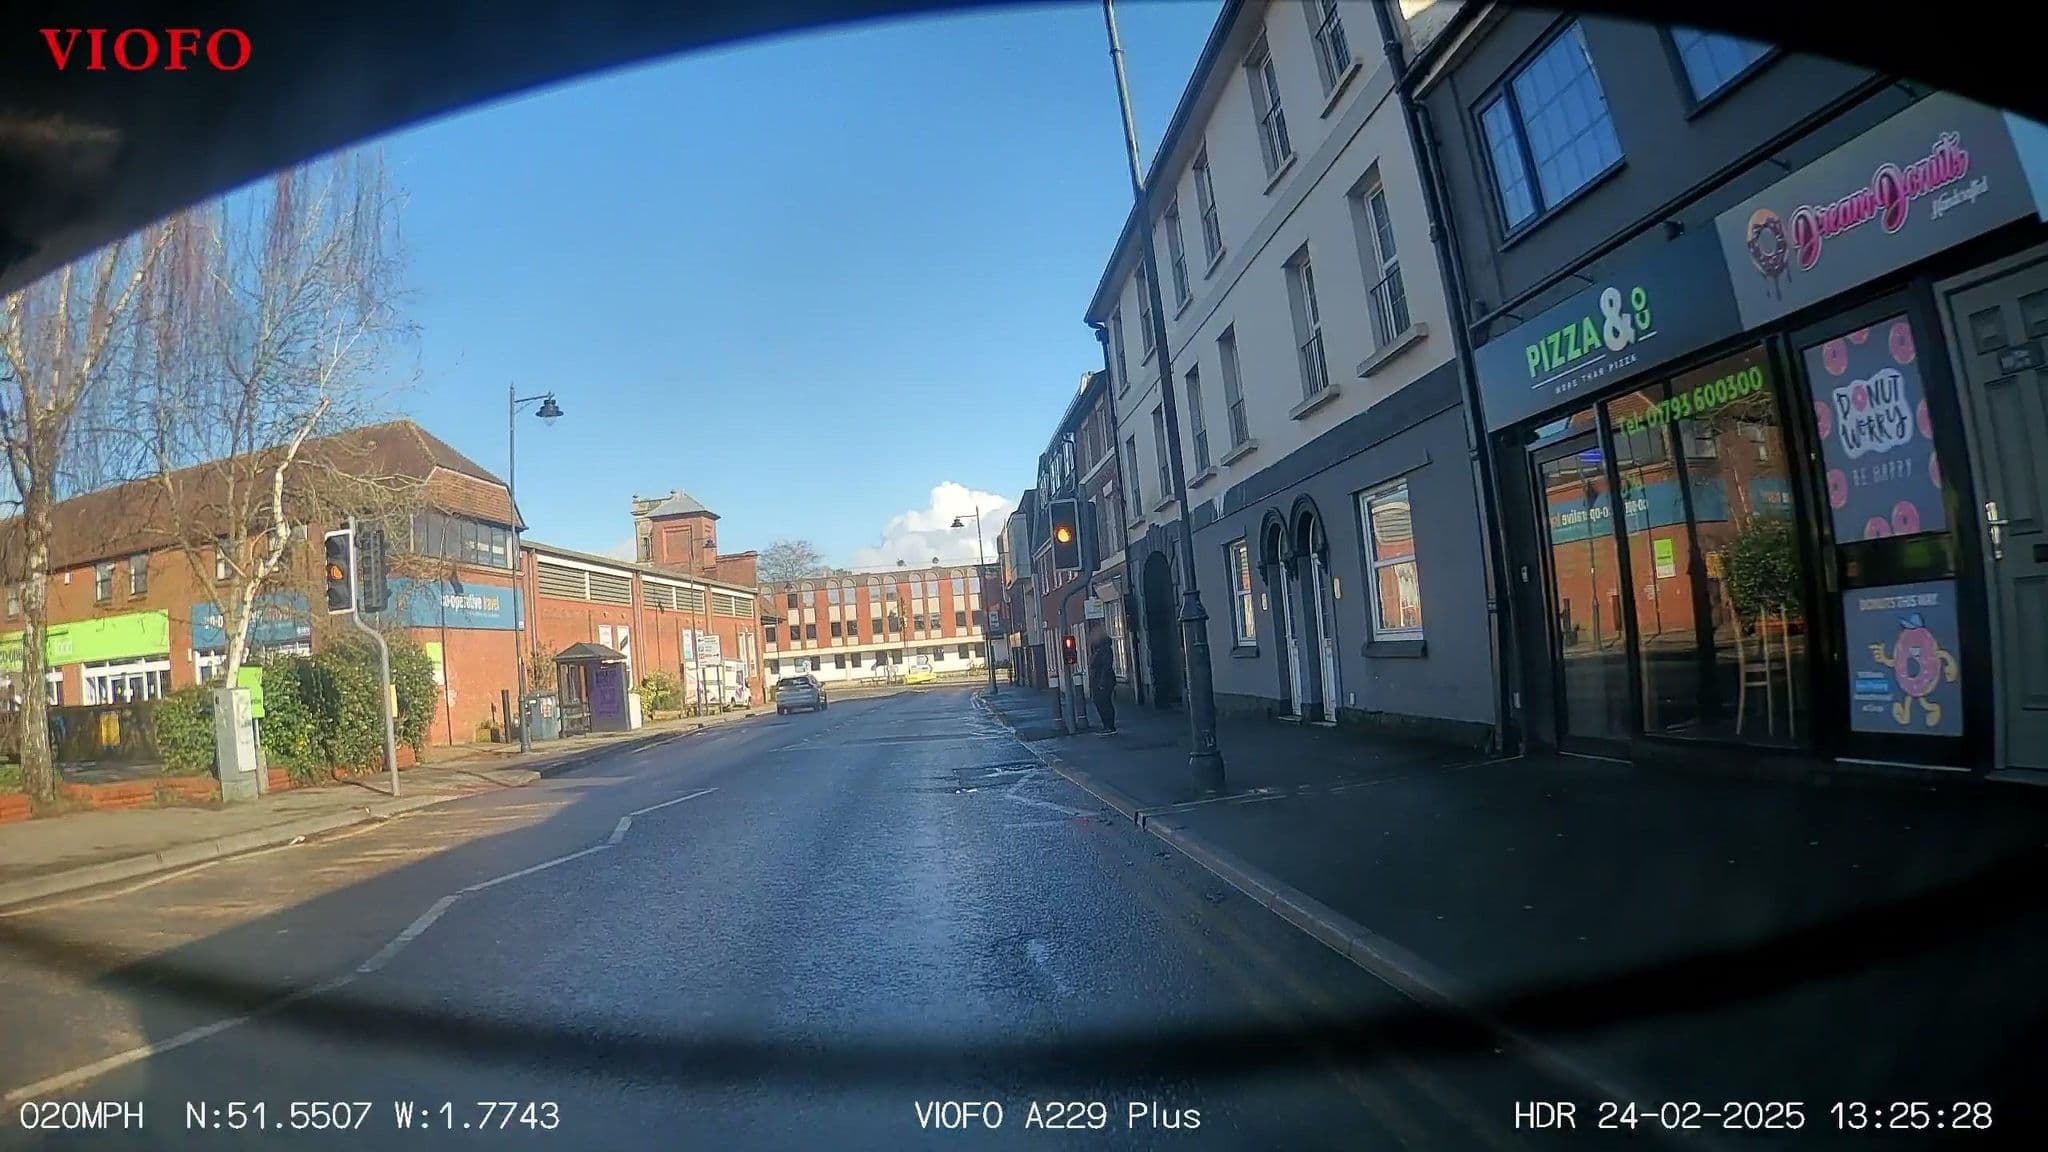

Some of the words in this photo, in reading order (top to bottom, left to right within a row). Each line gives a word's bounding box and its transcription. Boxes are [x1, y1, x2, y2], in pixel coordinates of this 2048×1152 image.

[1790, 188, 1876, 271] Dream
[1872, 130, 1969, 234] Donuts
[1525, 316, 1603, 379] PIZZA
[1600, 286, 1637, 352] &
[1646, 392, 1691, 428] 01793
[1693, 366, 1765, 412] 600300
